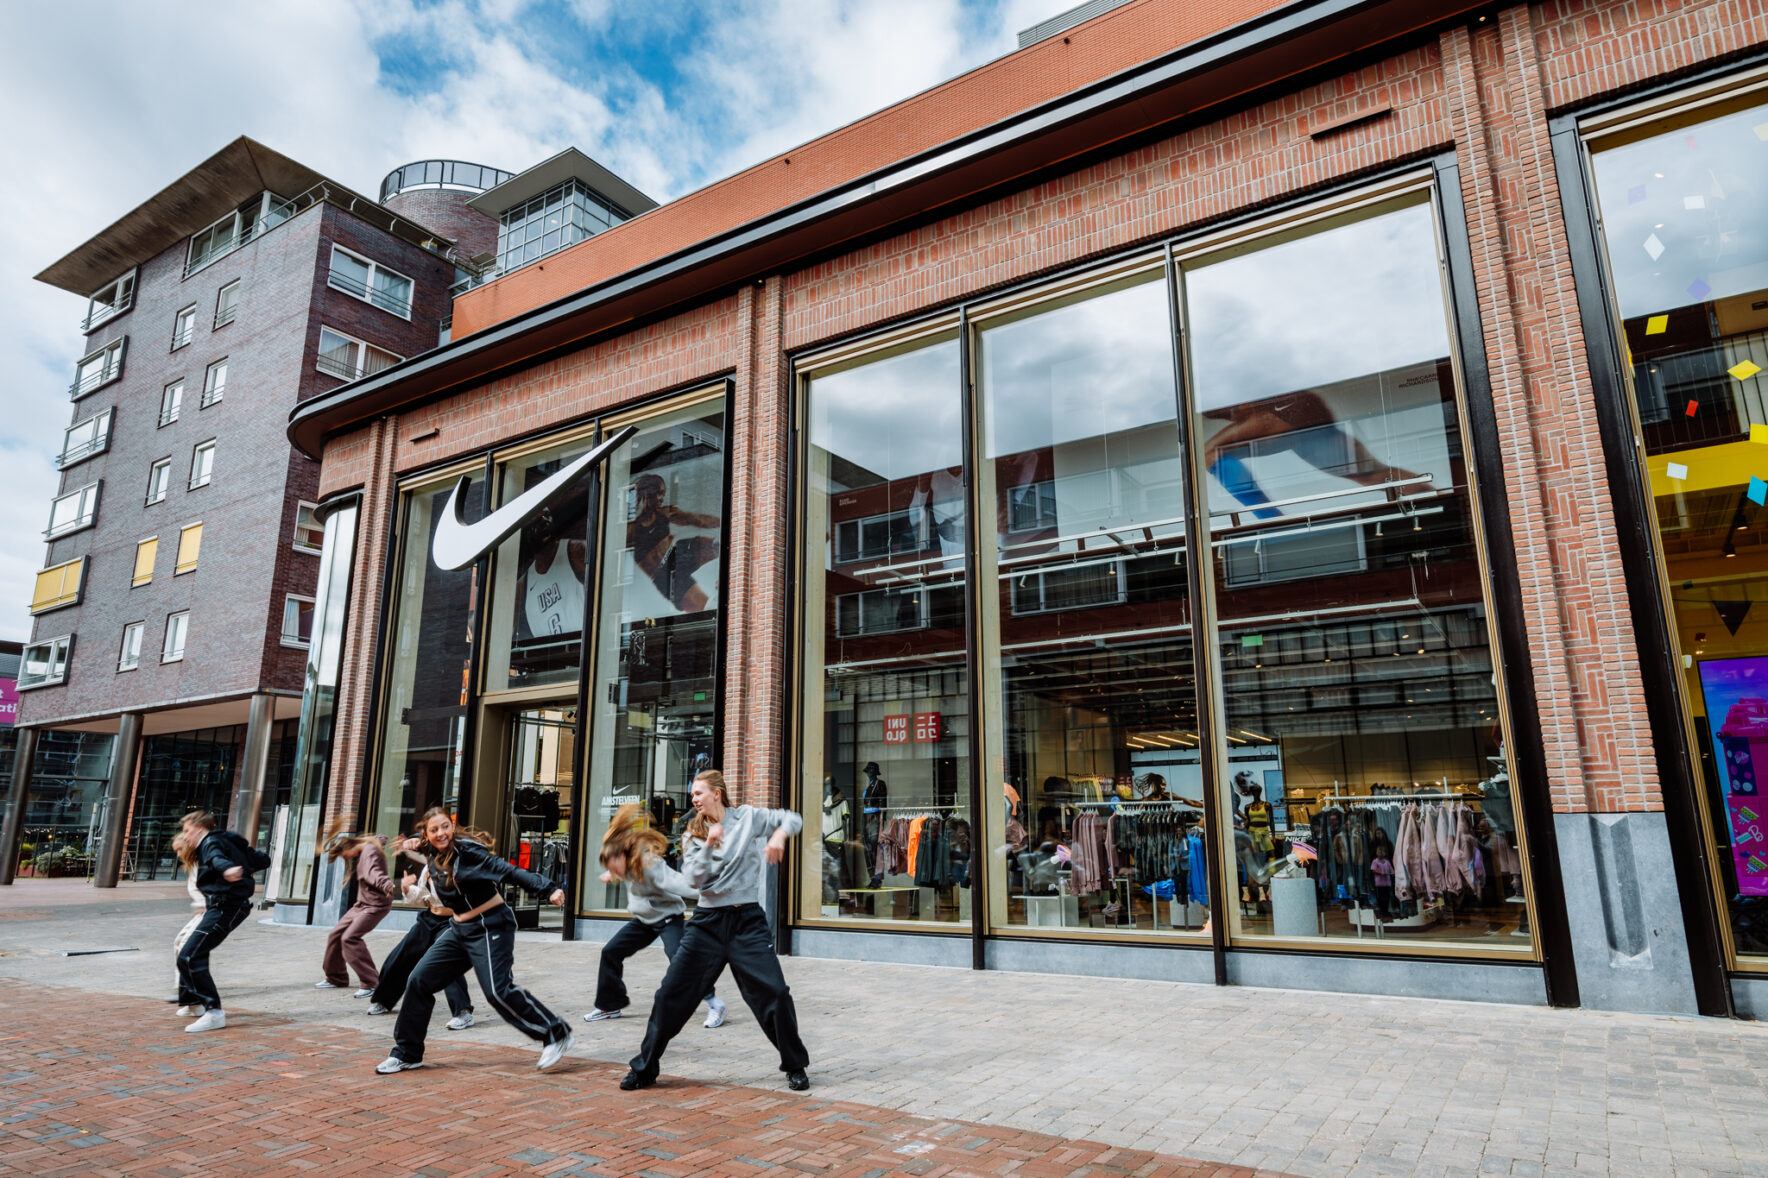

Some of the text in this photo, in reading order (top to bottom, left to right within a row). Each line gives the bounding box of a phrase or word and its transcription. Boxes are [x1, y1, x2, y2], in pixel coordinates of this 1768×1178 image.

[537, 582, 562, 613] USA
[601, 794, 641, 806] AMSTELVEEN
[1285, 835, 1308, 843] NIKE
